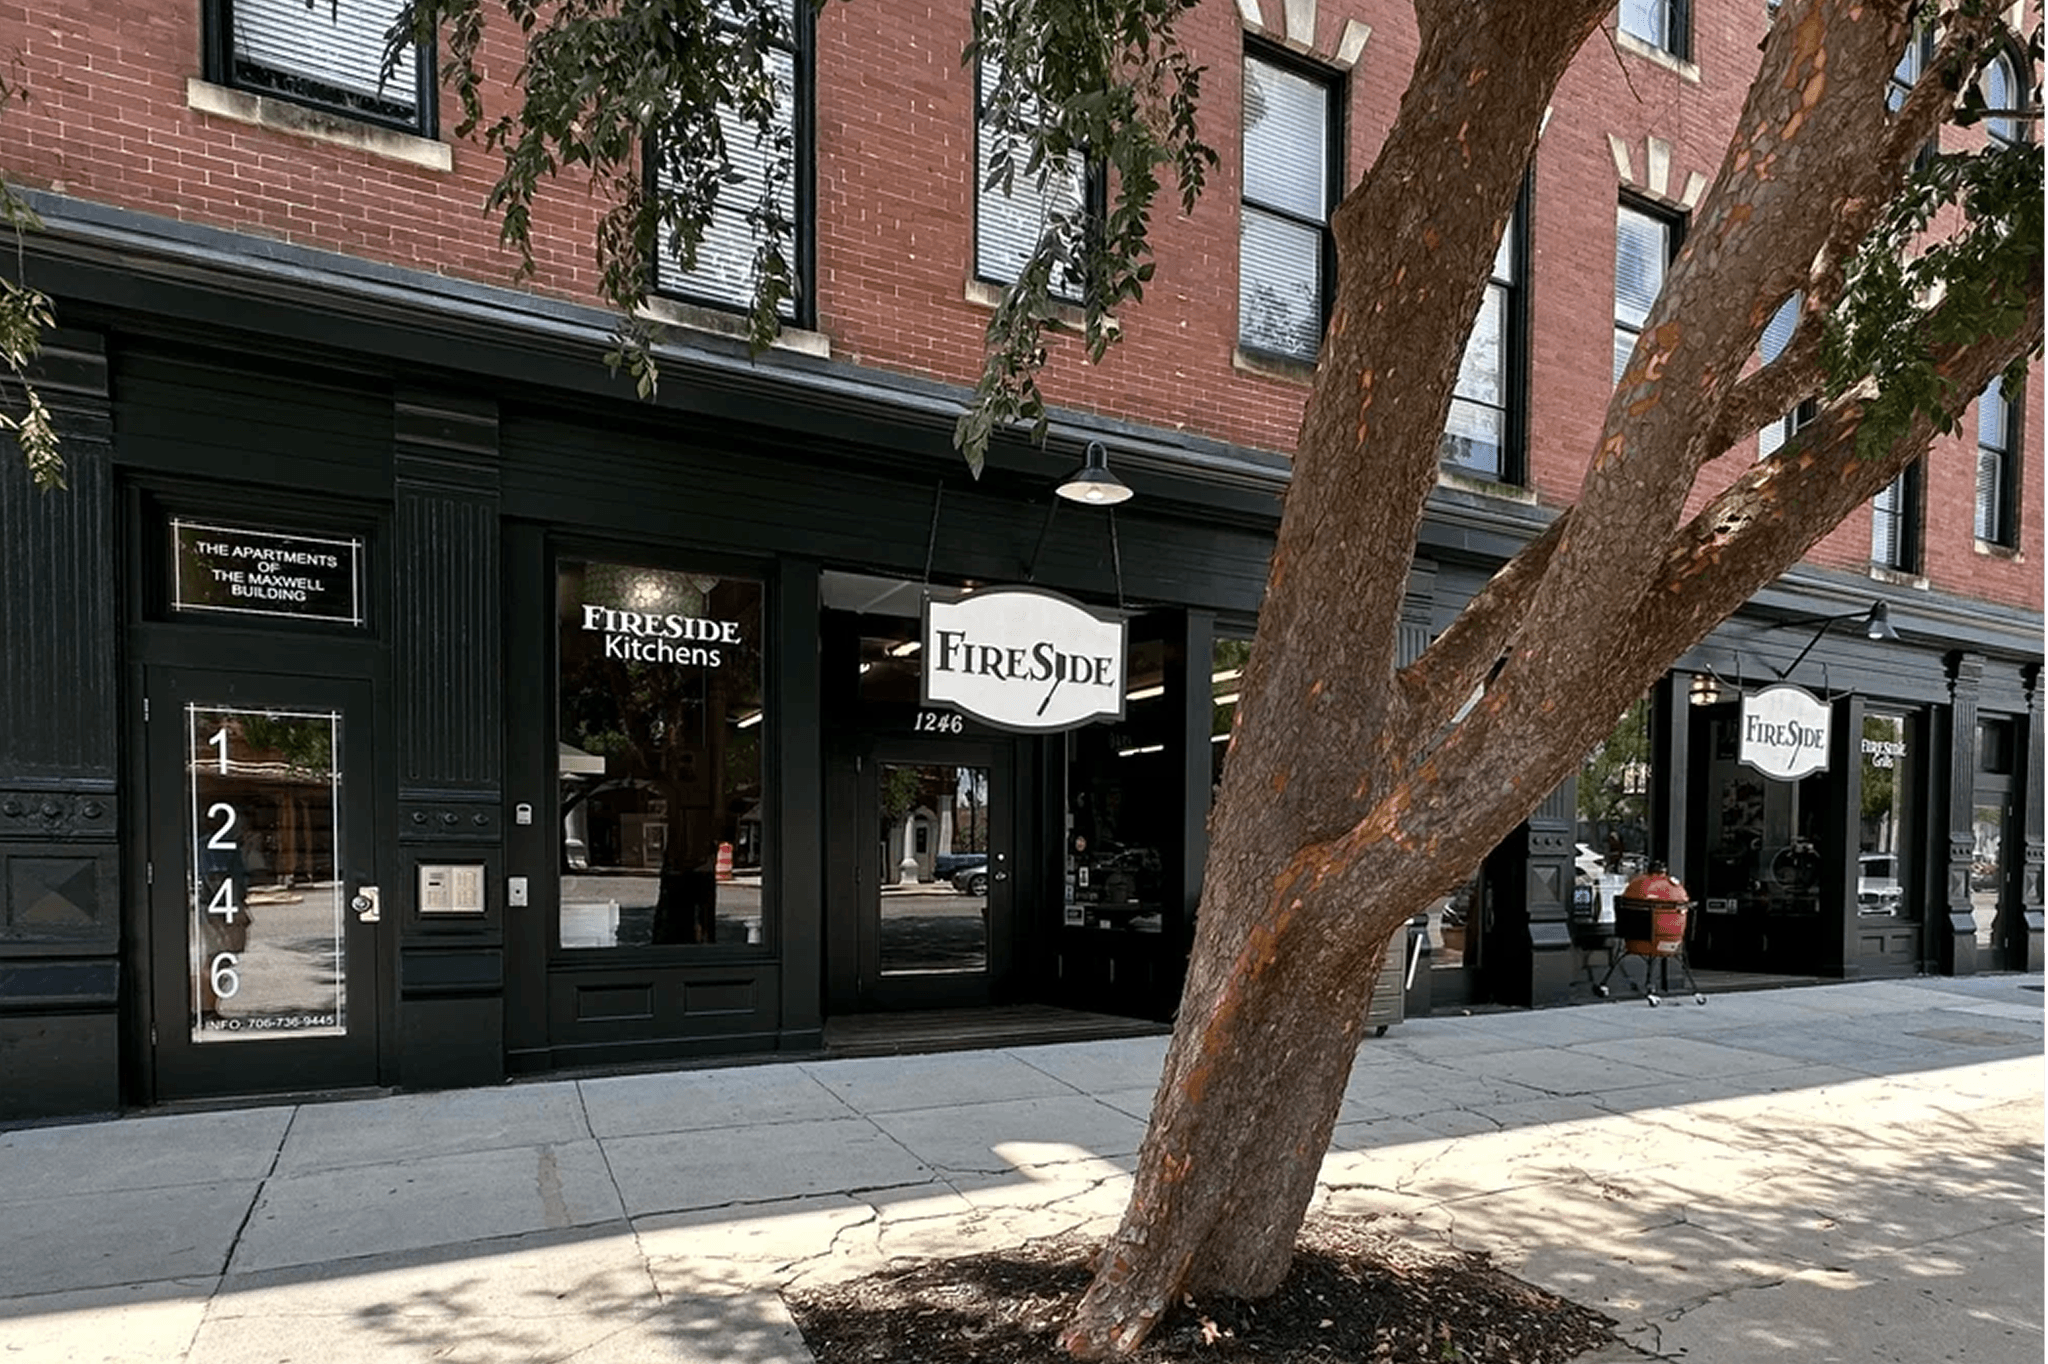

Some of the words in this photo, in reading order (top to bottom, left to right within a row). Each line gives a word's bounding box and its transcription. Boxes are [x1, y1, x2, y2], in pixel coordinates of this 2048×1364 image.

[197, 541, 229, 556] THE
[232, 546, 337, 568] APARTMENTS
[257, 561, 280, 573] OF
[212, 569, 244, 583] THE
[248, 573, 325, 591] MAXWELL
[231, 584, 306, 601] BUILDING
[605, 634, 721, 667] Kitchens
[914, 712, 963, 733] 1246
[250, 1015, 334, 1029] 706-736-9445
